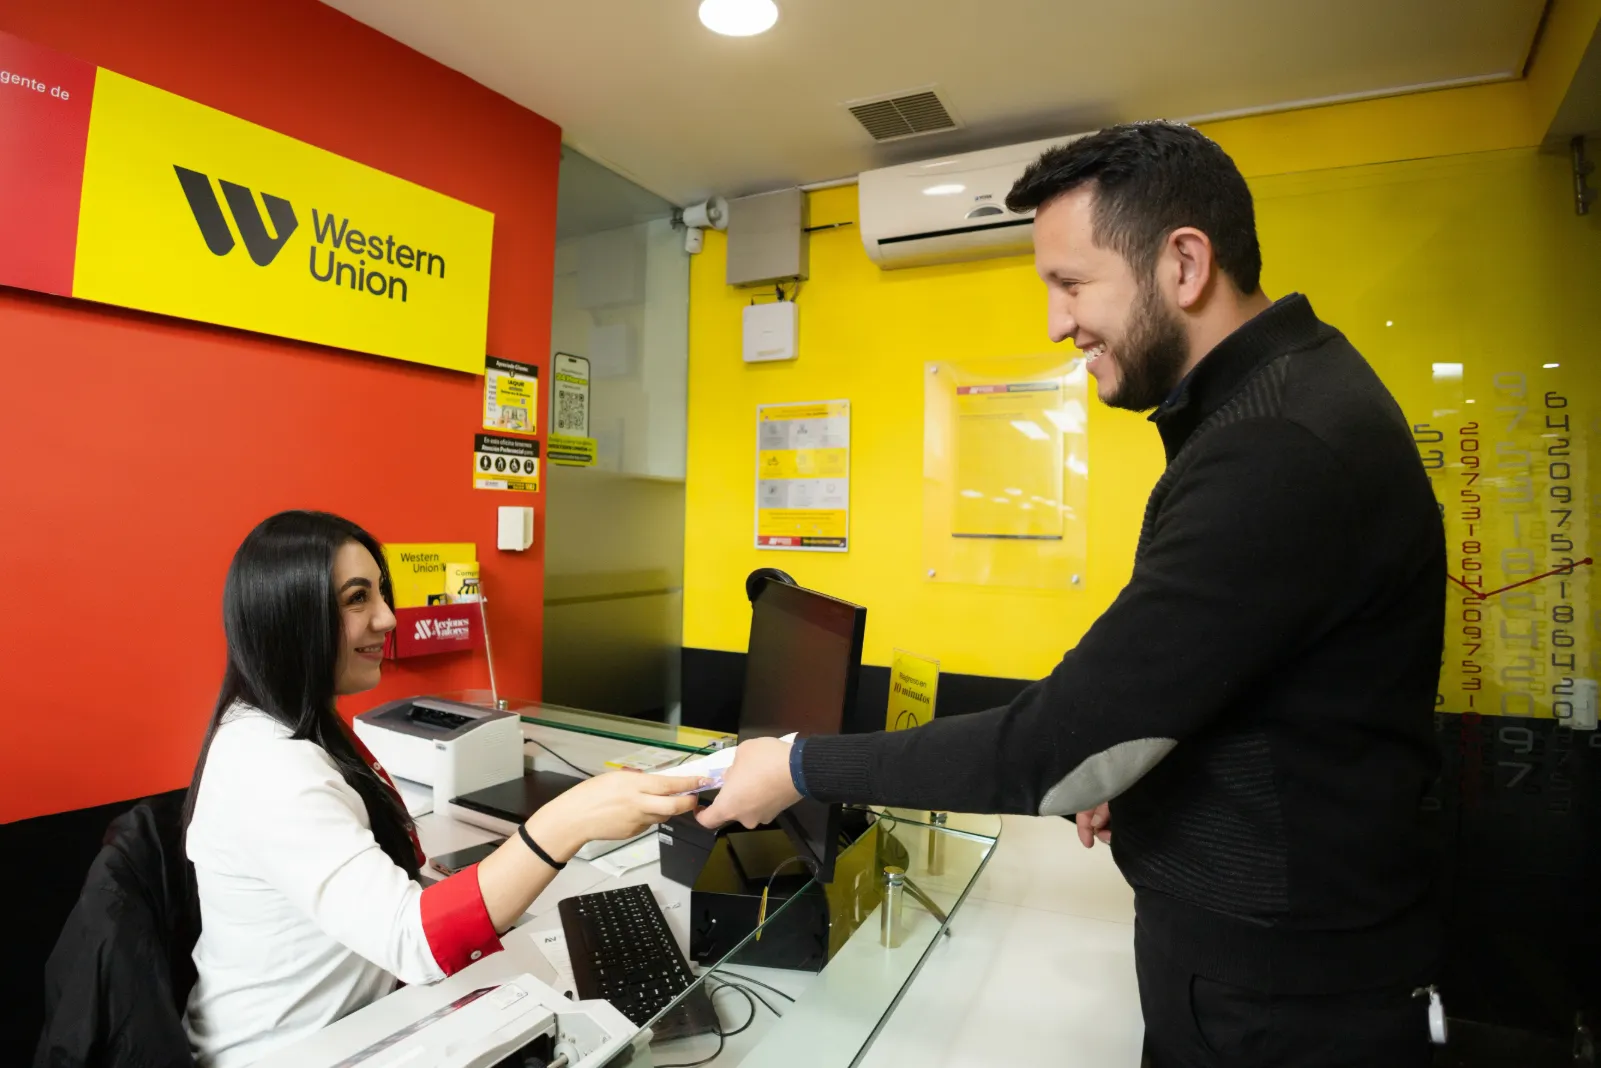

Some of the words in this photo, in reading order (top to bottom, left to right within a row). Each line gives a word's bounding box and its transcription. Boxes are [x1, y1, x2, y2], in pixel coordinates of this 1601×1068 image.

[50, 85, 70, 101] de
[311, 208, 446, 279] Western
[309, 246, 408, 303] Union
[400, 553, 439, 562] Western
[413, 563, 439, 573] Union
[434, 618, 469, 629] Acciones
[893, 682, 902, 693] 10
[902, 687, 930, 703] minutos
